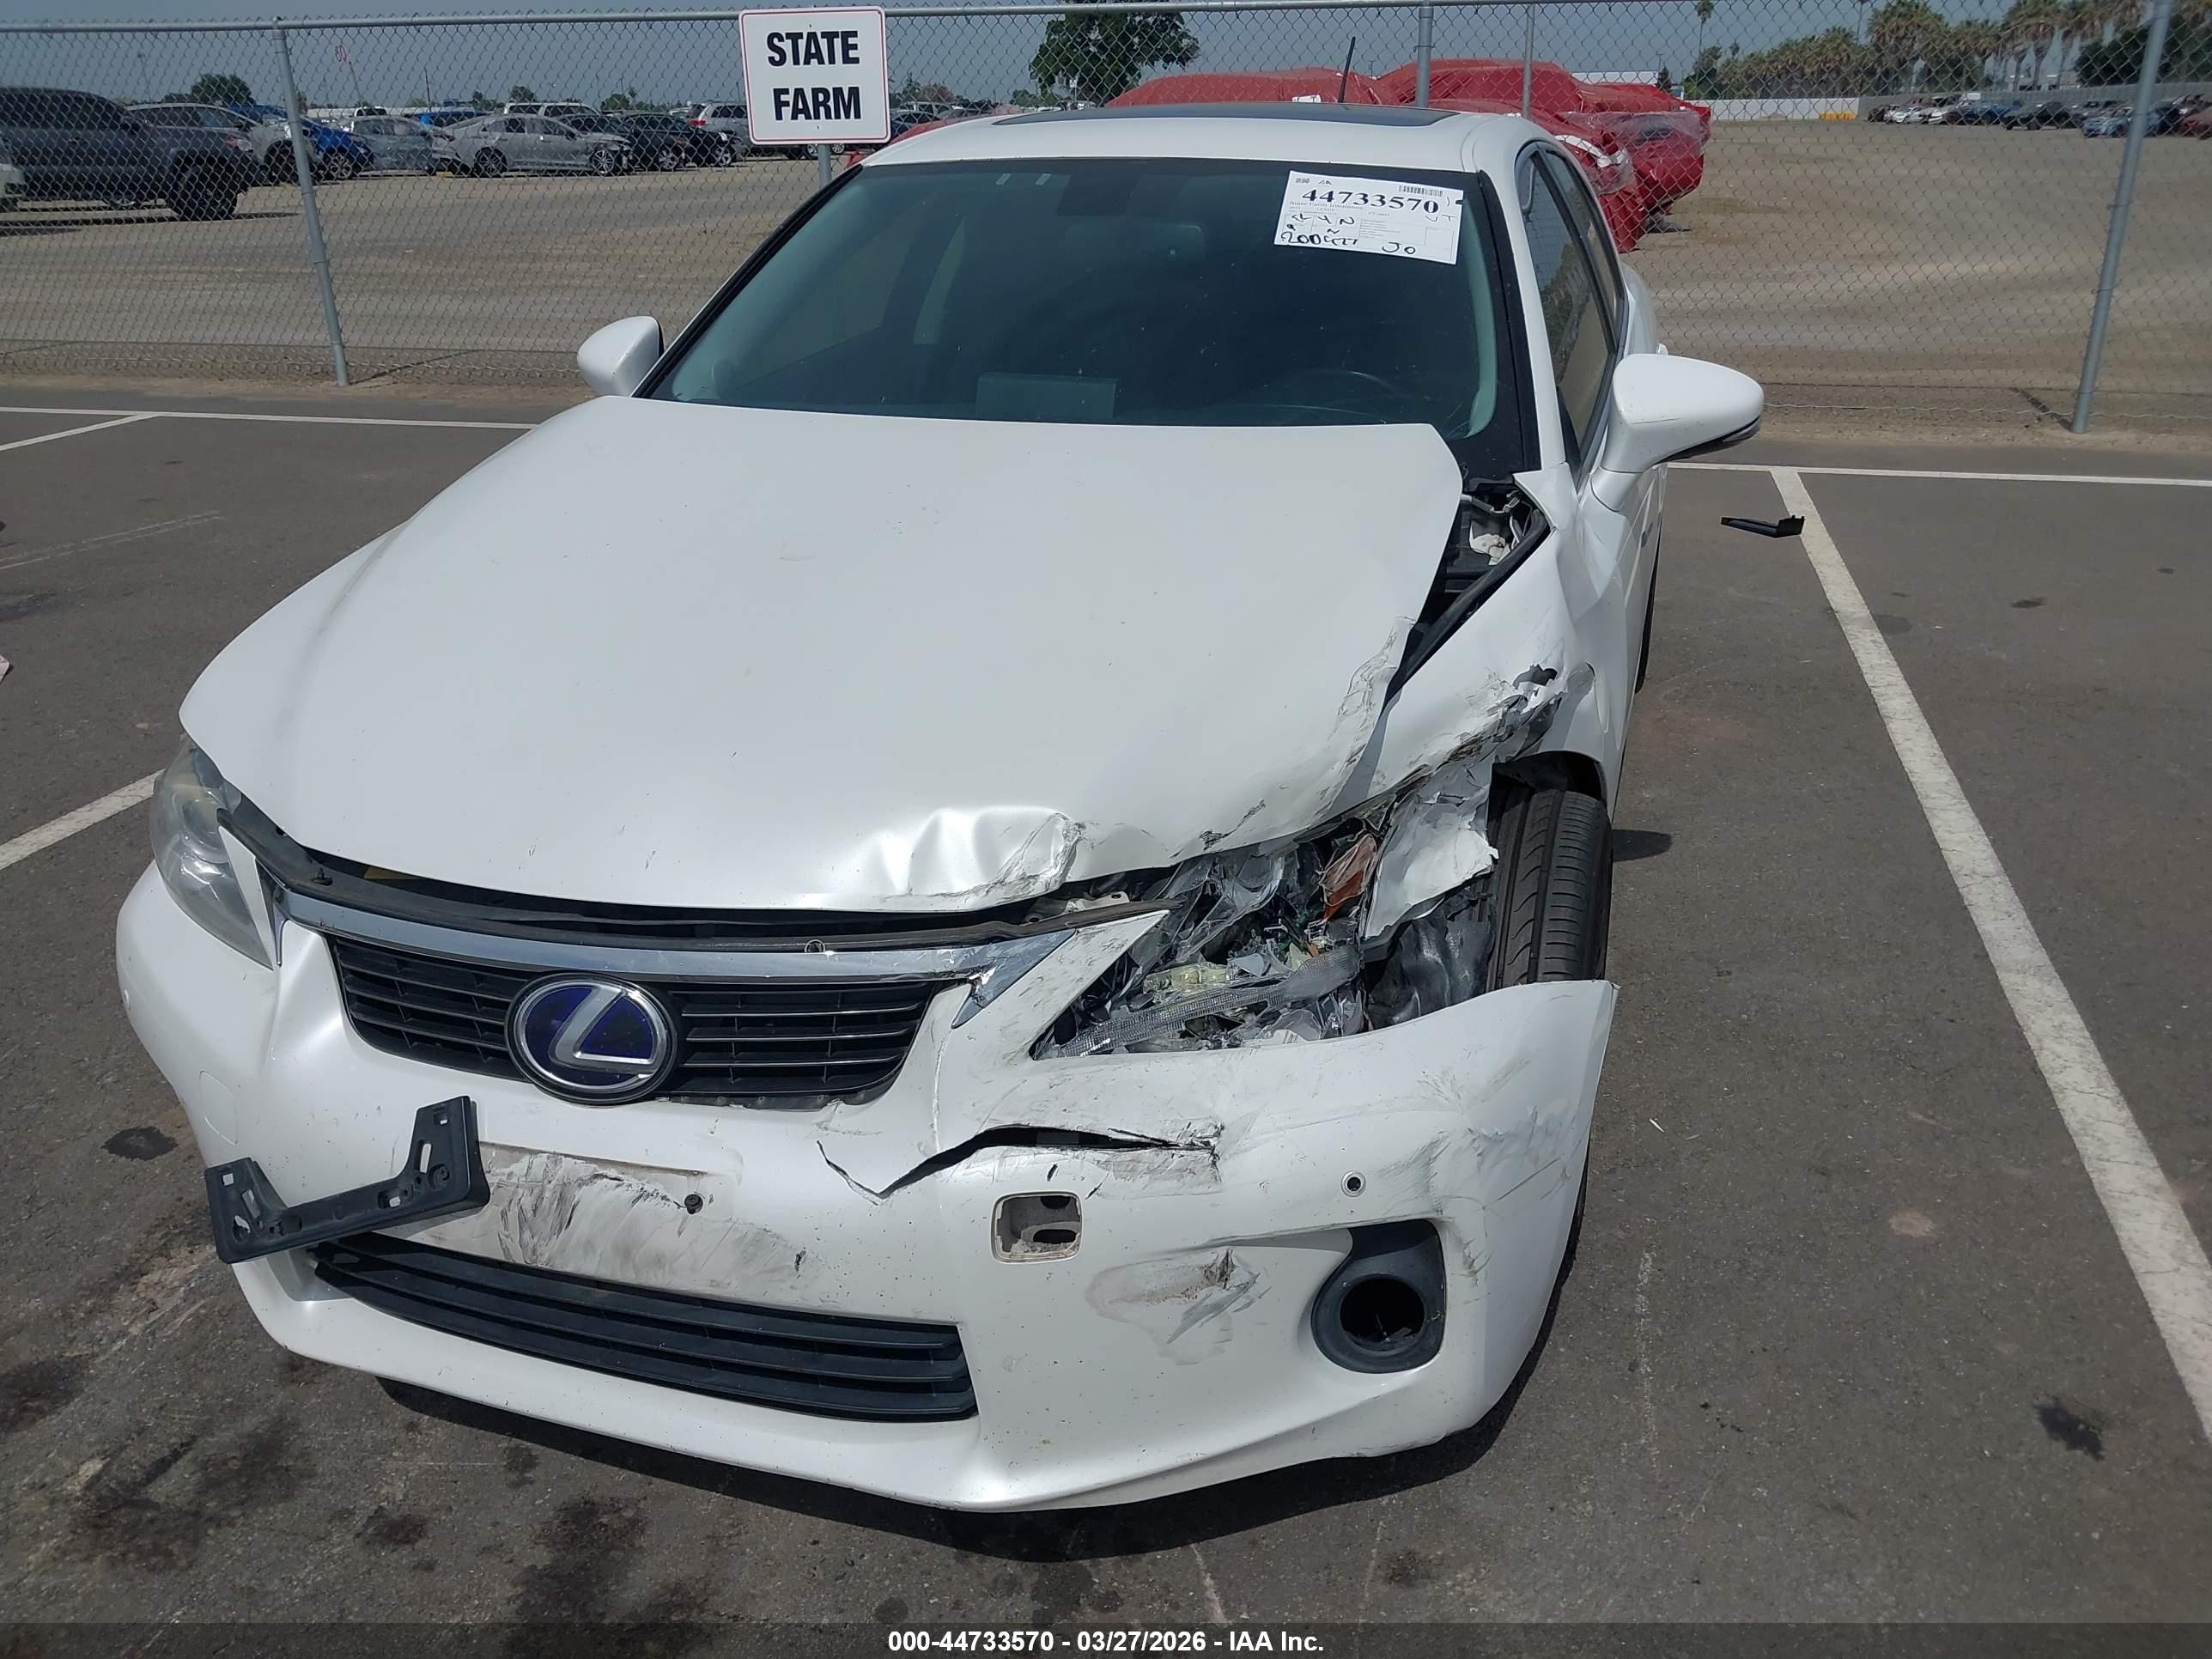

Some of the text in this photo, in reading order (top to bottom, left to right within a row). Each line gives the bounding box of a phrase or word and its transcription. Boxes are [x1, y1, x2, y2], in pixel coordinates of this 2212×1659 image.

[767, 31, 860, 67] STATE
[773, 87, 861, 121] FARM
[1302, 189, 1439, 214] 44733570
